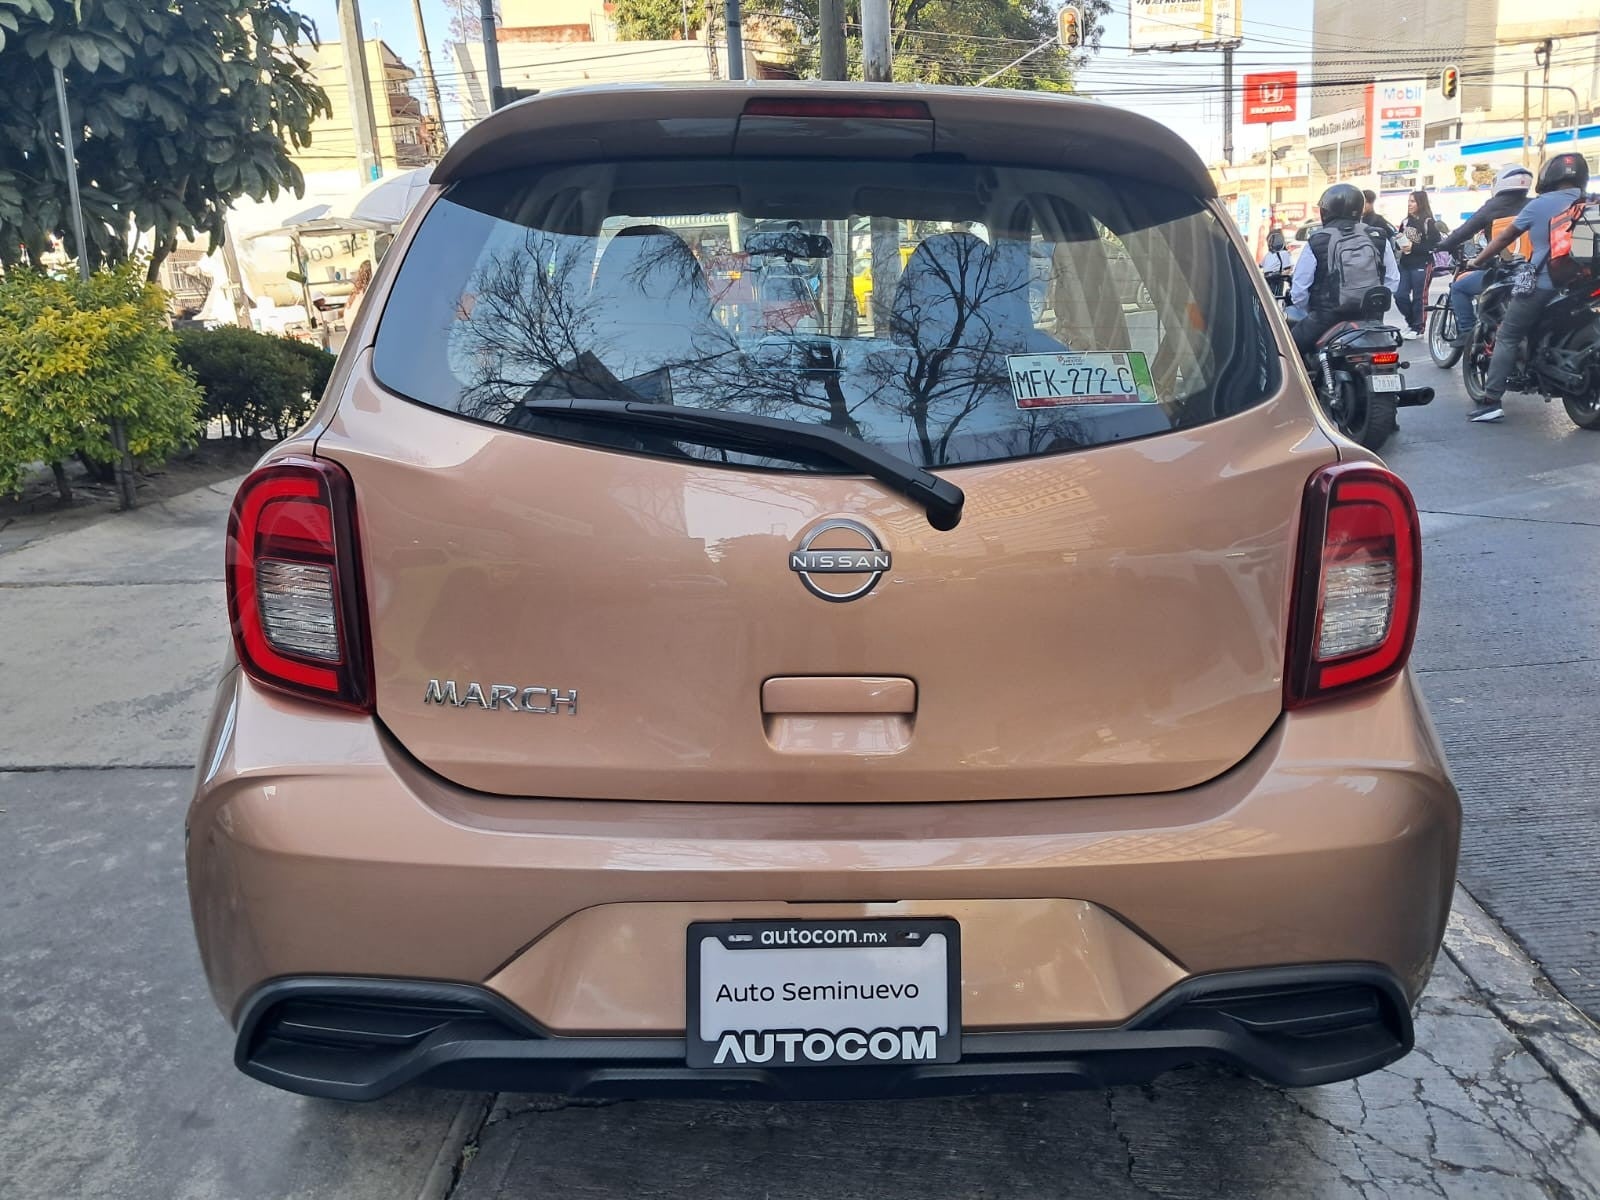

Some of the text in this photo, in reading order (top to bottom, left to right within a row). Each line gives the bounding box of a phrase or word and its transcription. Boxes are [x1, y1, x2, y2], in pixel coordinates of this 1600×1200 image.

[1384, 86, 1421, 100] Mobil
[1250, 105, 1293, 115] HONDA
[1015, 367, 1134, 398] MFK-272-C
[792, 555, 889, 568] NISSAN
[424, 679, 578, 715] MARCH
[760, 927, 887, 945] autocom.mx
[715, 981, 919, 1002] Auto Seminuevo
[713, 1030, 937, 1064] AUTOCOM
